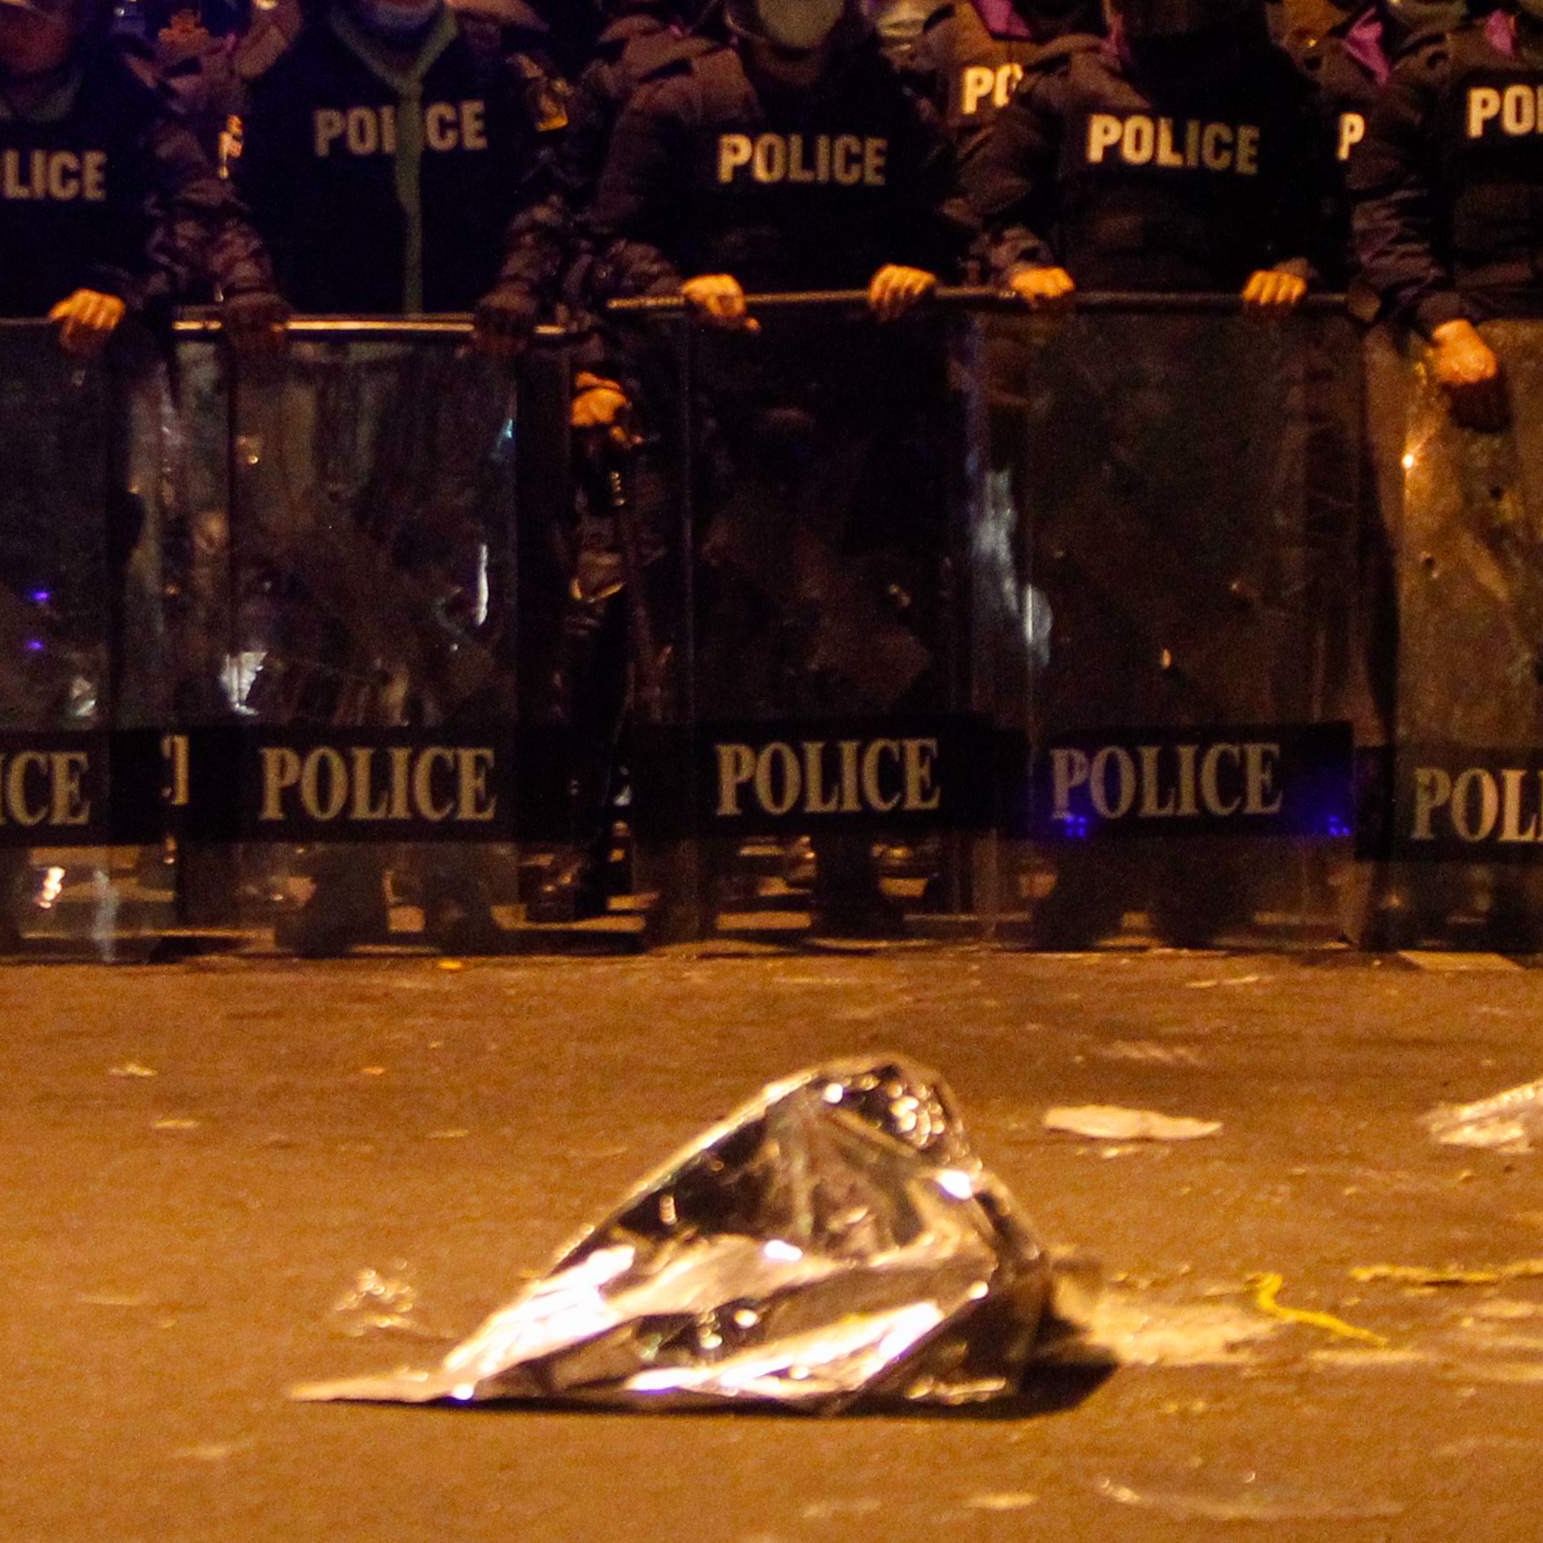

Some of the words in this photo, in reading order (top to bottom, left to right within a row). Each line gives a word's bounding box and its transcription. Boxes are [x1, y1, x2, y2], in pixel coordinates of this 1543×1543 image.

[719, 134, 888, 185] POLICE
[1087, 114, 1259, 174] POLICE
[262, 747, 494, 821] POLICE
[717, 739, 938, 815] POLICE
[1051, 743, 1280, 819] POLICE
